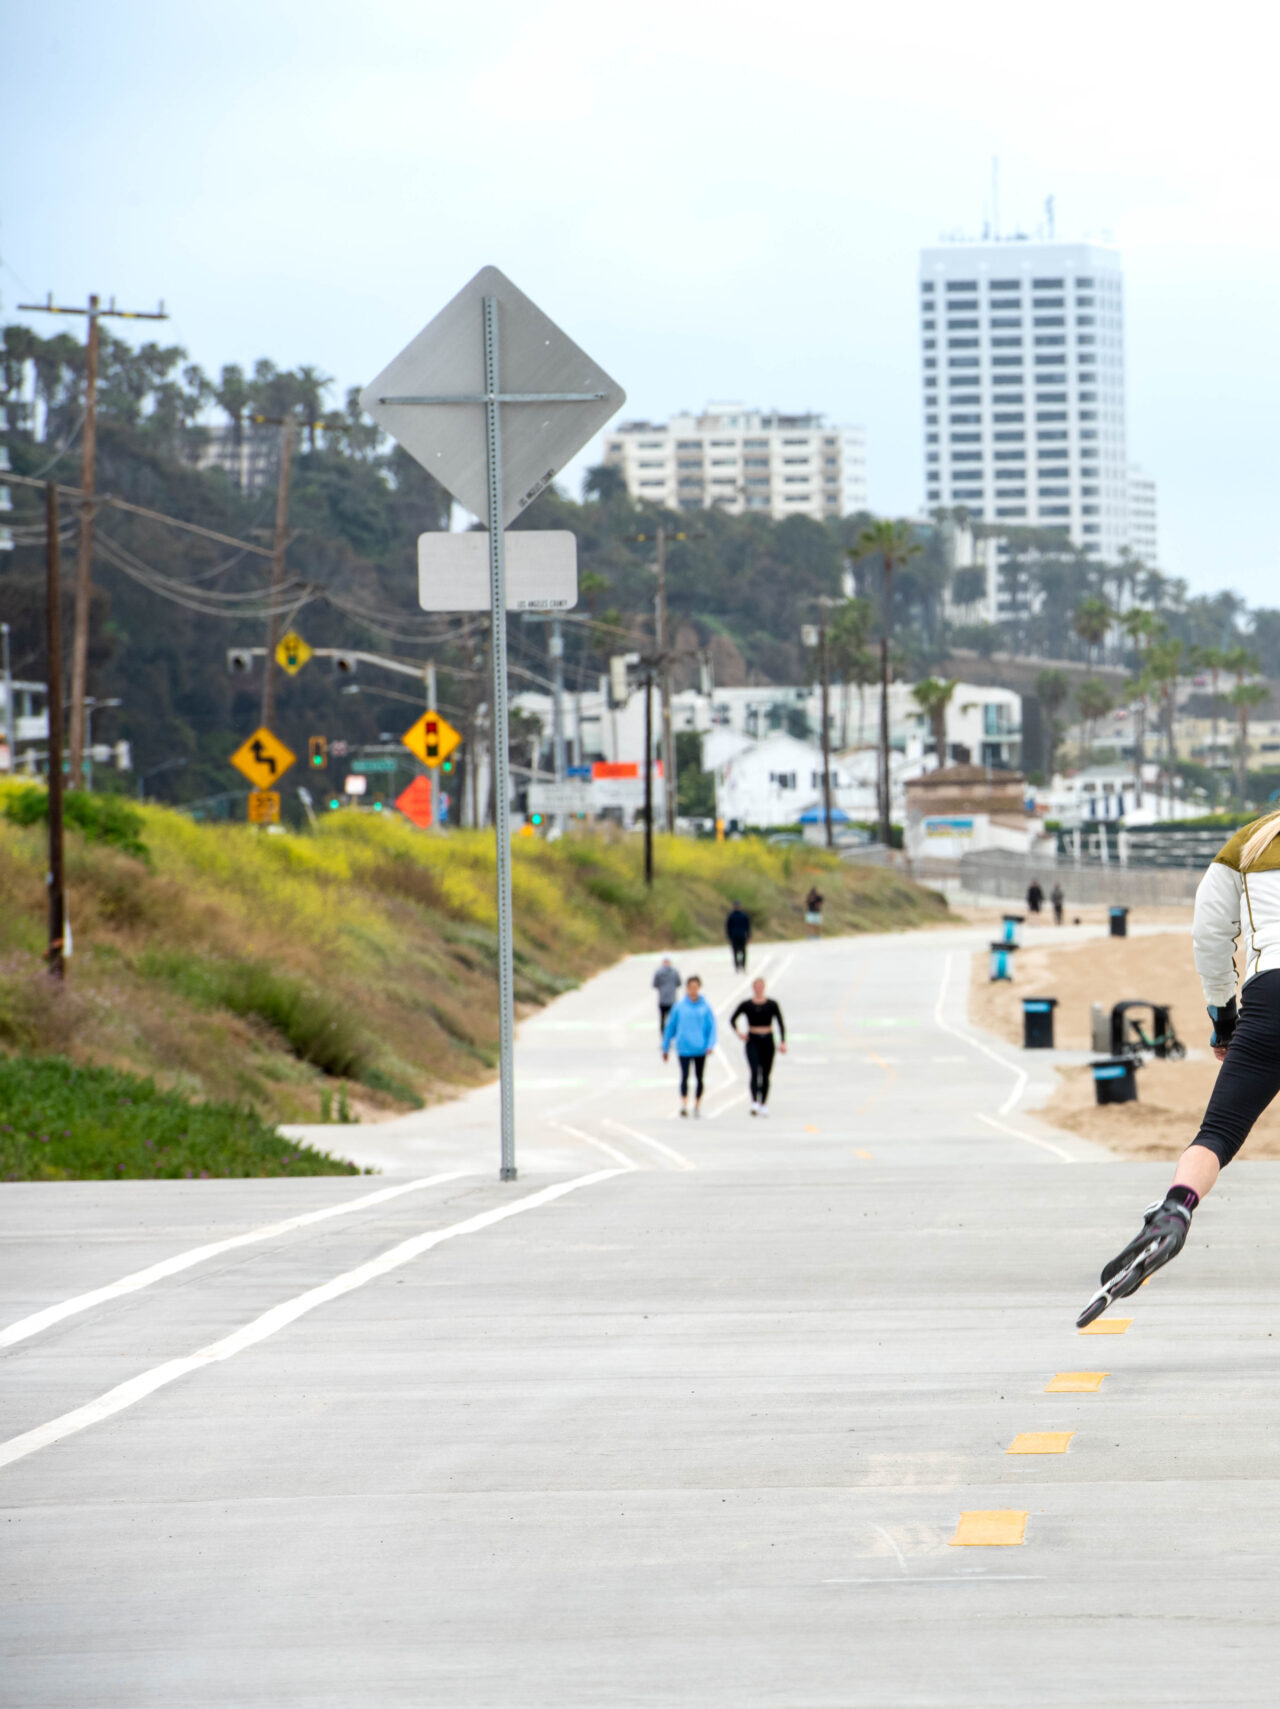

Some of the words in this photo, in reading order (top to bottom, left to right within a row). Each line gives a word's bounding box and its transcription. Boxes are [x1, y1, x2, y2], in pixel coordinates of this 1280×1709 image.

[518, 600, 526, 608] LOS
[528, 599, 548, 608] ANGELES
[549, 599, 568, 608] COUNTY
